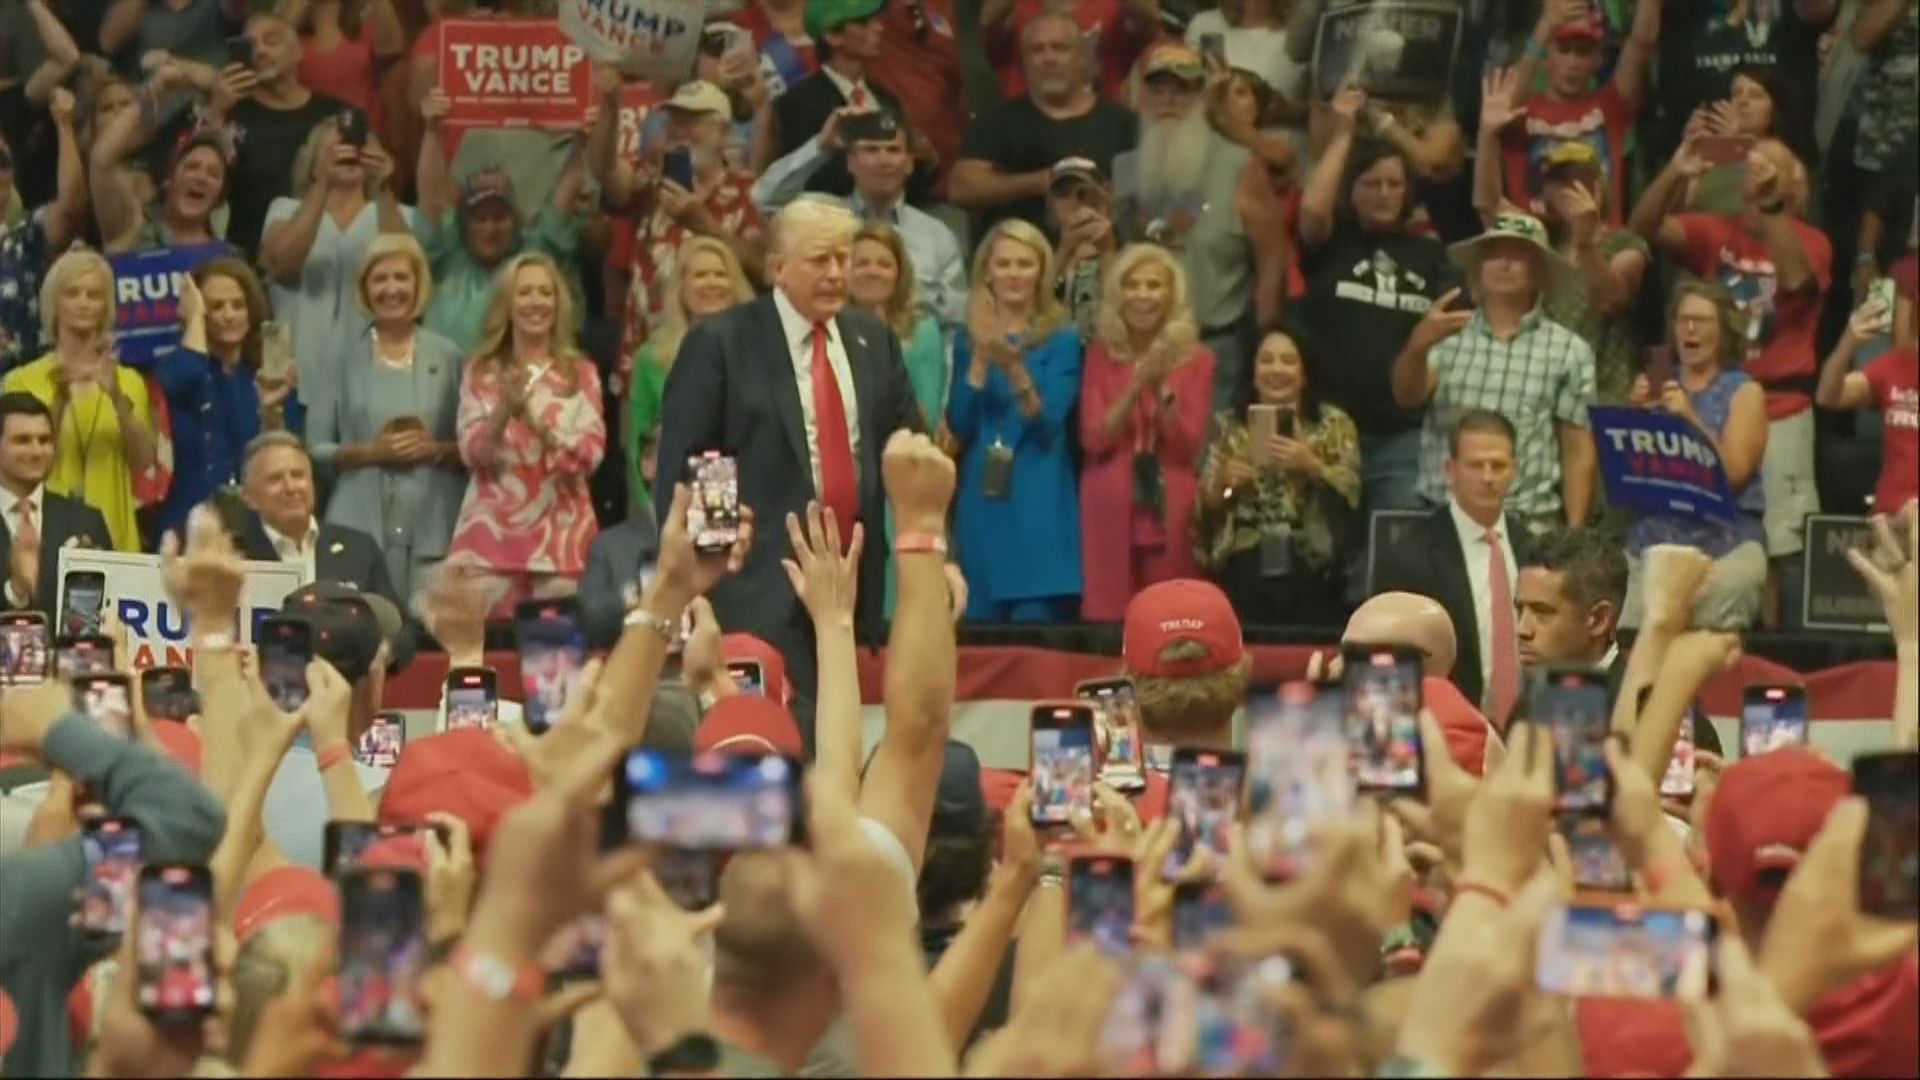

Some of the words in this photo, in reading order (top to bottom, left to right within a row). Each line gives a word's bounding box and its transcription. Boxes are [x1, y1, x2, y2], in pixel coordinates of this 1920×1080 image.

[1334, 16, 1441, 42] NER
[450, 43, 583, 71] TRUMP
[465, 71, 571, 93] VANCE
[117, 599, 282, 643] RUP
